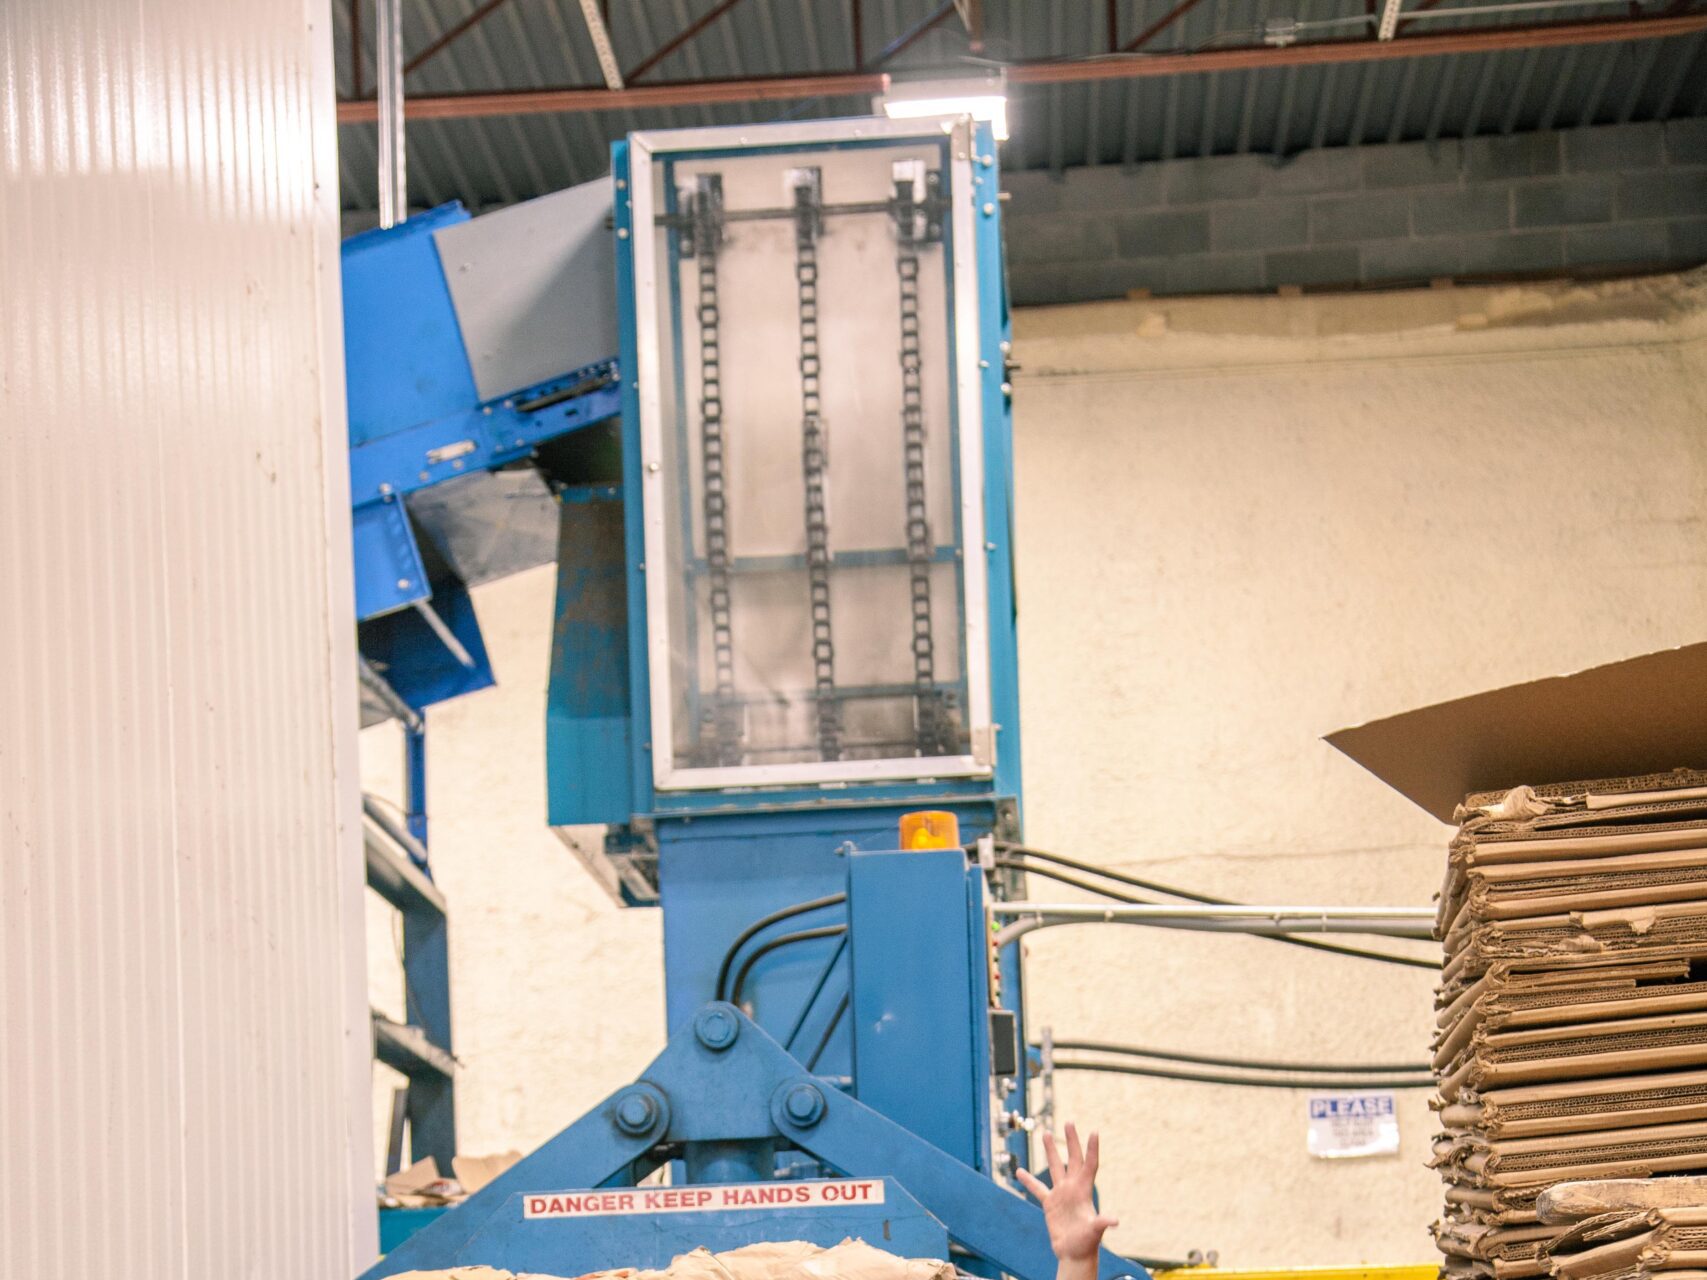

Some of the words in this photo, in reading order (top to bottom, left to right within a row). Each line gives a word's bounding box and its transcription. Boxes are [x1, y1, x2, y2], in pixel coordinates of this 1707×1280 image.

[1311, 1097, 1392, 1118] PLEASE
[530, 1194, 634, 1214] DANGER
[645, 1191, 712, 1210] KEEP
[723, 1187, 810, 1206] HANDS
[821, 1184, 872, 1202] OUT
